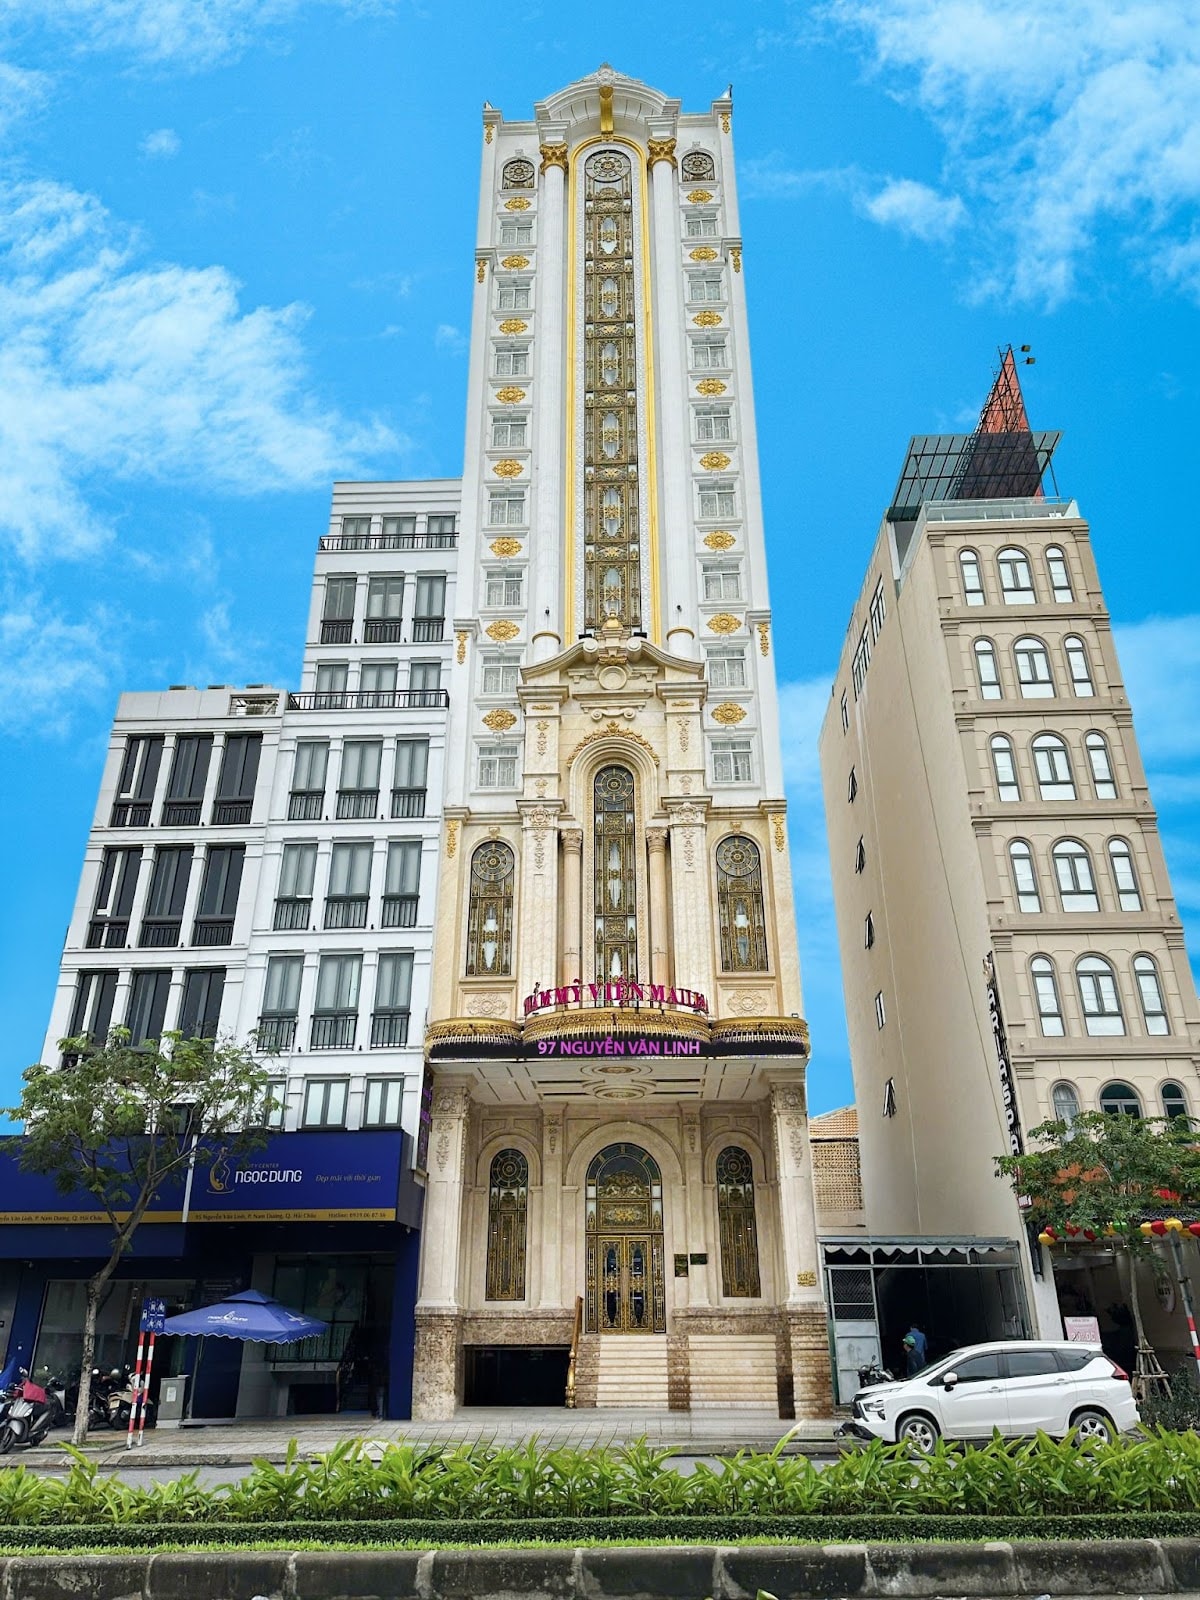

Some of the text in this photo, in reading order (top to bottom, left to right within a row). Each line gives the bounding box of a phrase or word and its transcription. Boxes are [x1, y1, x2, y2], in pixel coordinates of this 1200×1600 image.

[588, 976, 644, 1007] VIỆN
[538, 1036, 700, 1055] 97 NGUYỄN VĂN LINH
